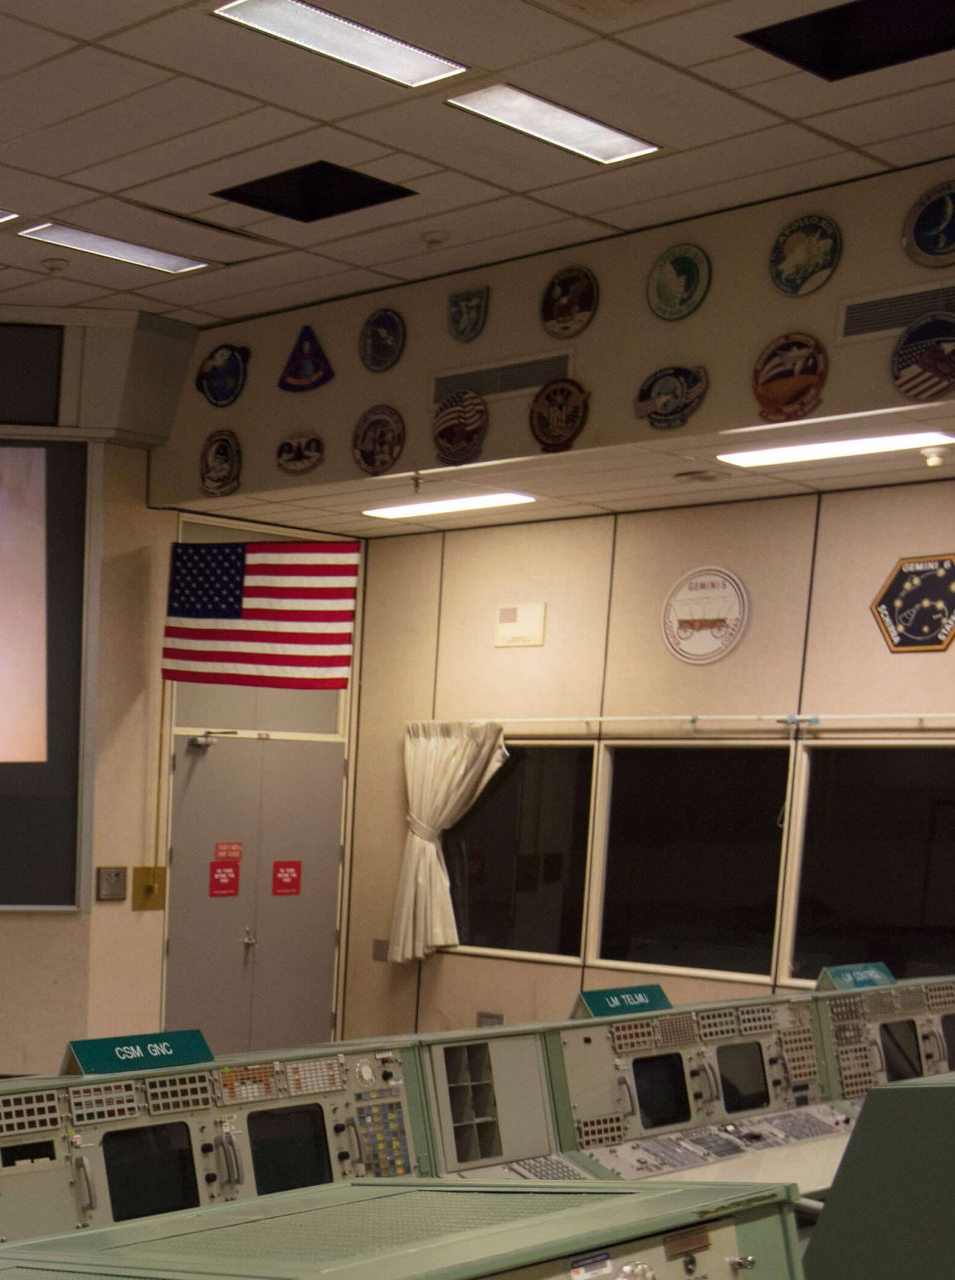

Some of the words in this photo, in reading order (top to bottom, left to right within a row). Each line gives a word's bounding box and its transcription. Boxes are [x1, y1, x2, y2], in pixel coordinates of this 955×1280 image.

[902, 561, 939, 573] GEMINI
[687, 582, 720, 592] GEMINI
[115, 1045, 144, 1060] CSM
[147, 1042, 173, 1056] GNC
